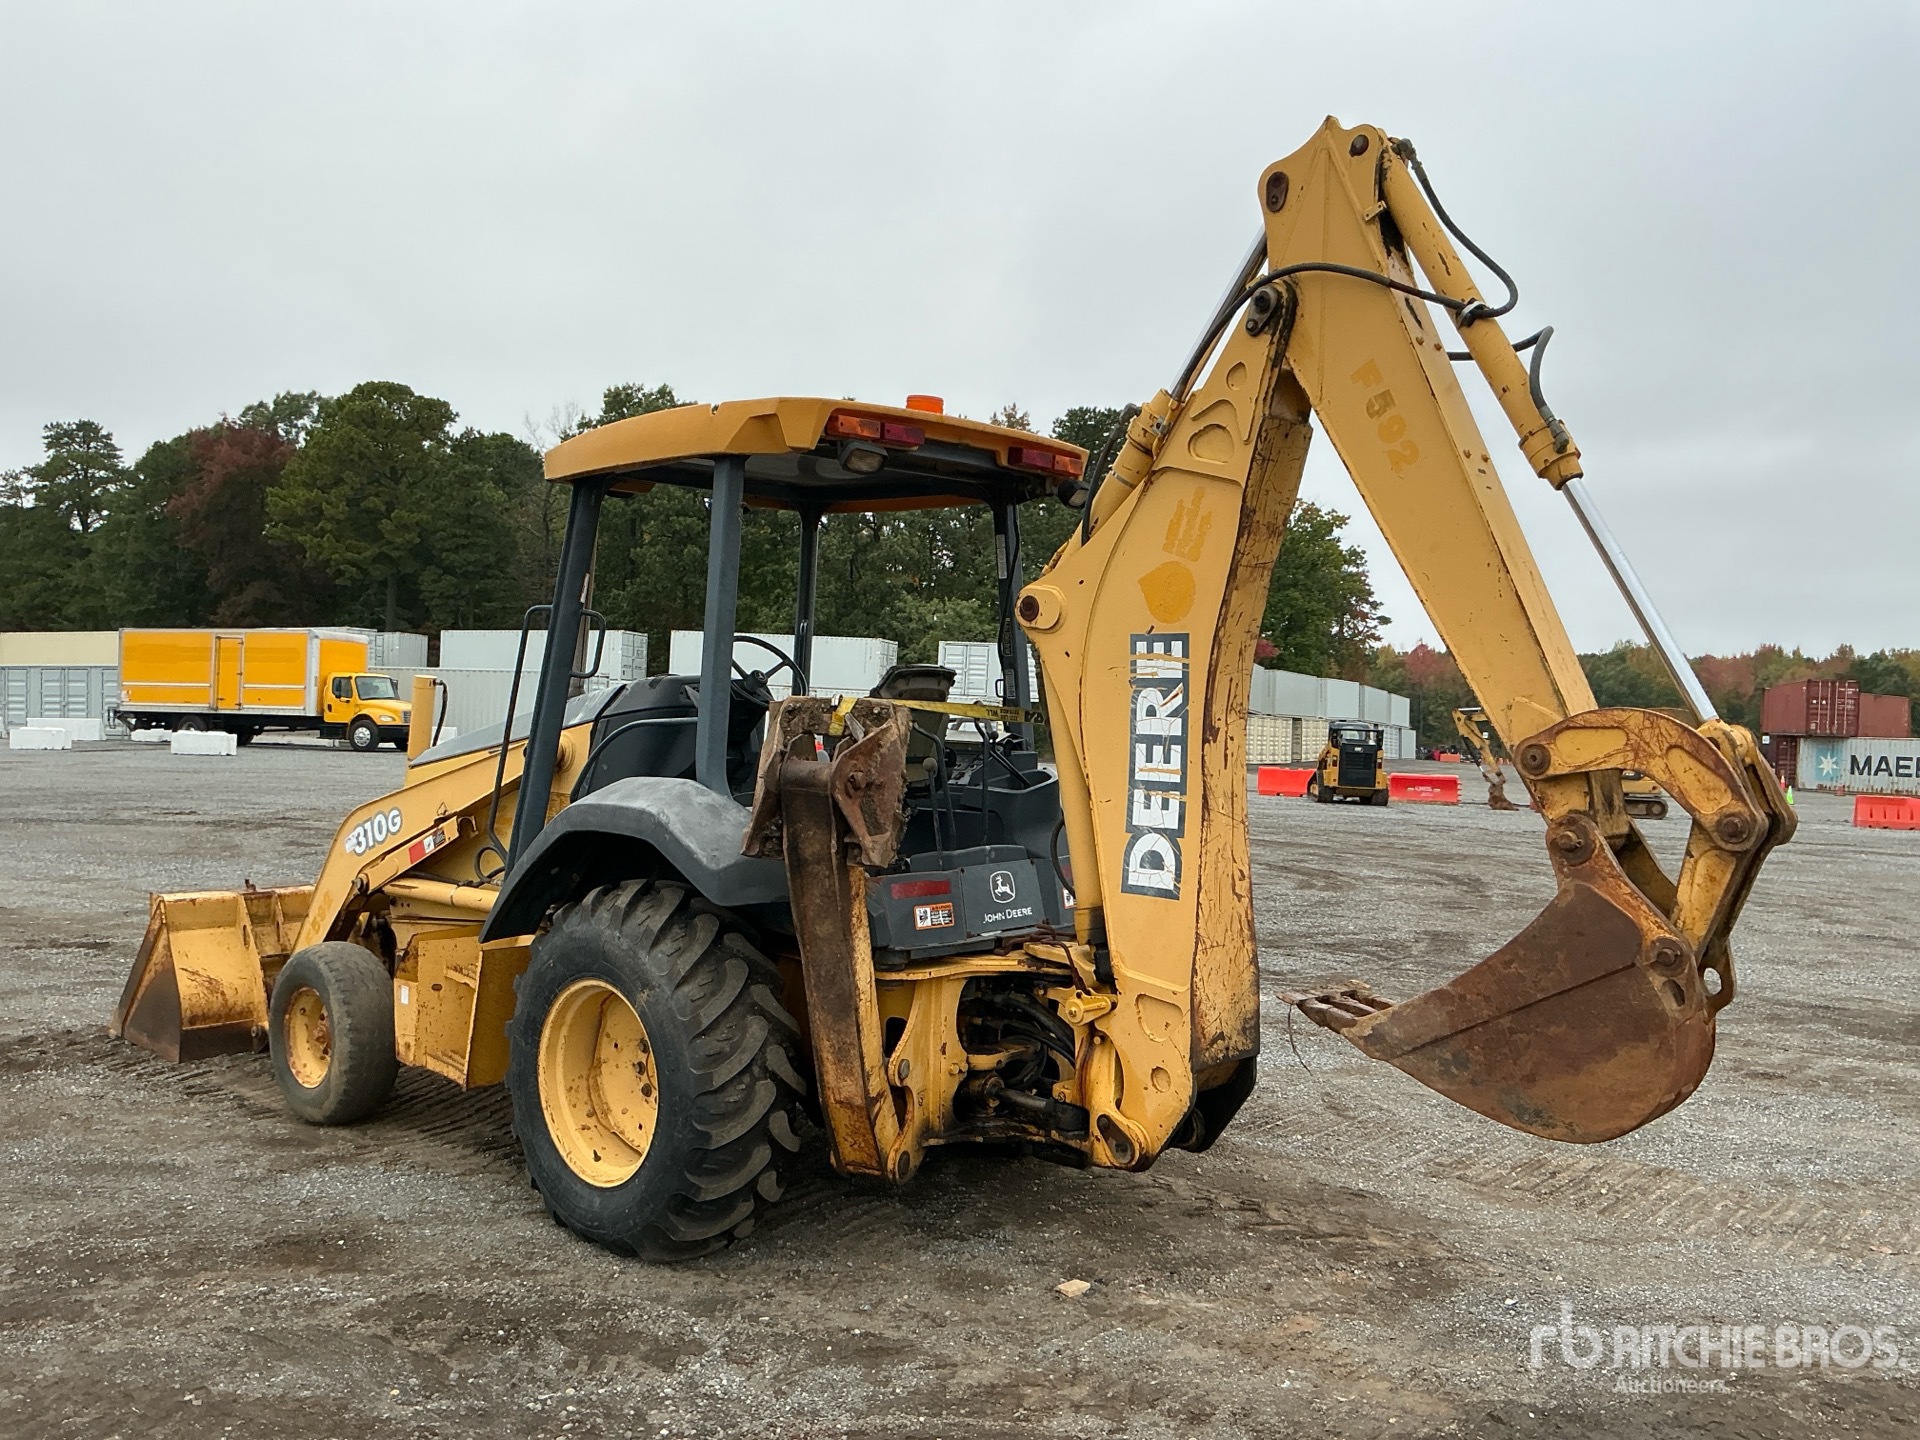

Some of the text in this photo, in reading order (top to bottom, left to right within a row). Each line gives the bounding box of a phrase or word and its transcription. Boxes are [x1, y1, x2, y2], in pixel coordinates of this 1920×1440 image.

[1349, 358, 1420, 475] F592
[1127, 640, 1184, 891] DEERE
[353, 807, 402, 855] 310G
[982, 907, 1033, 924] JOHN DEERE
